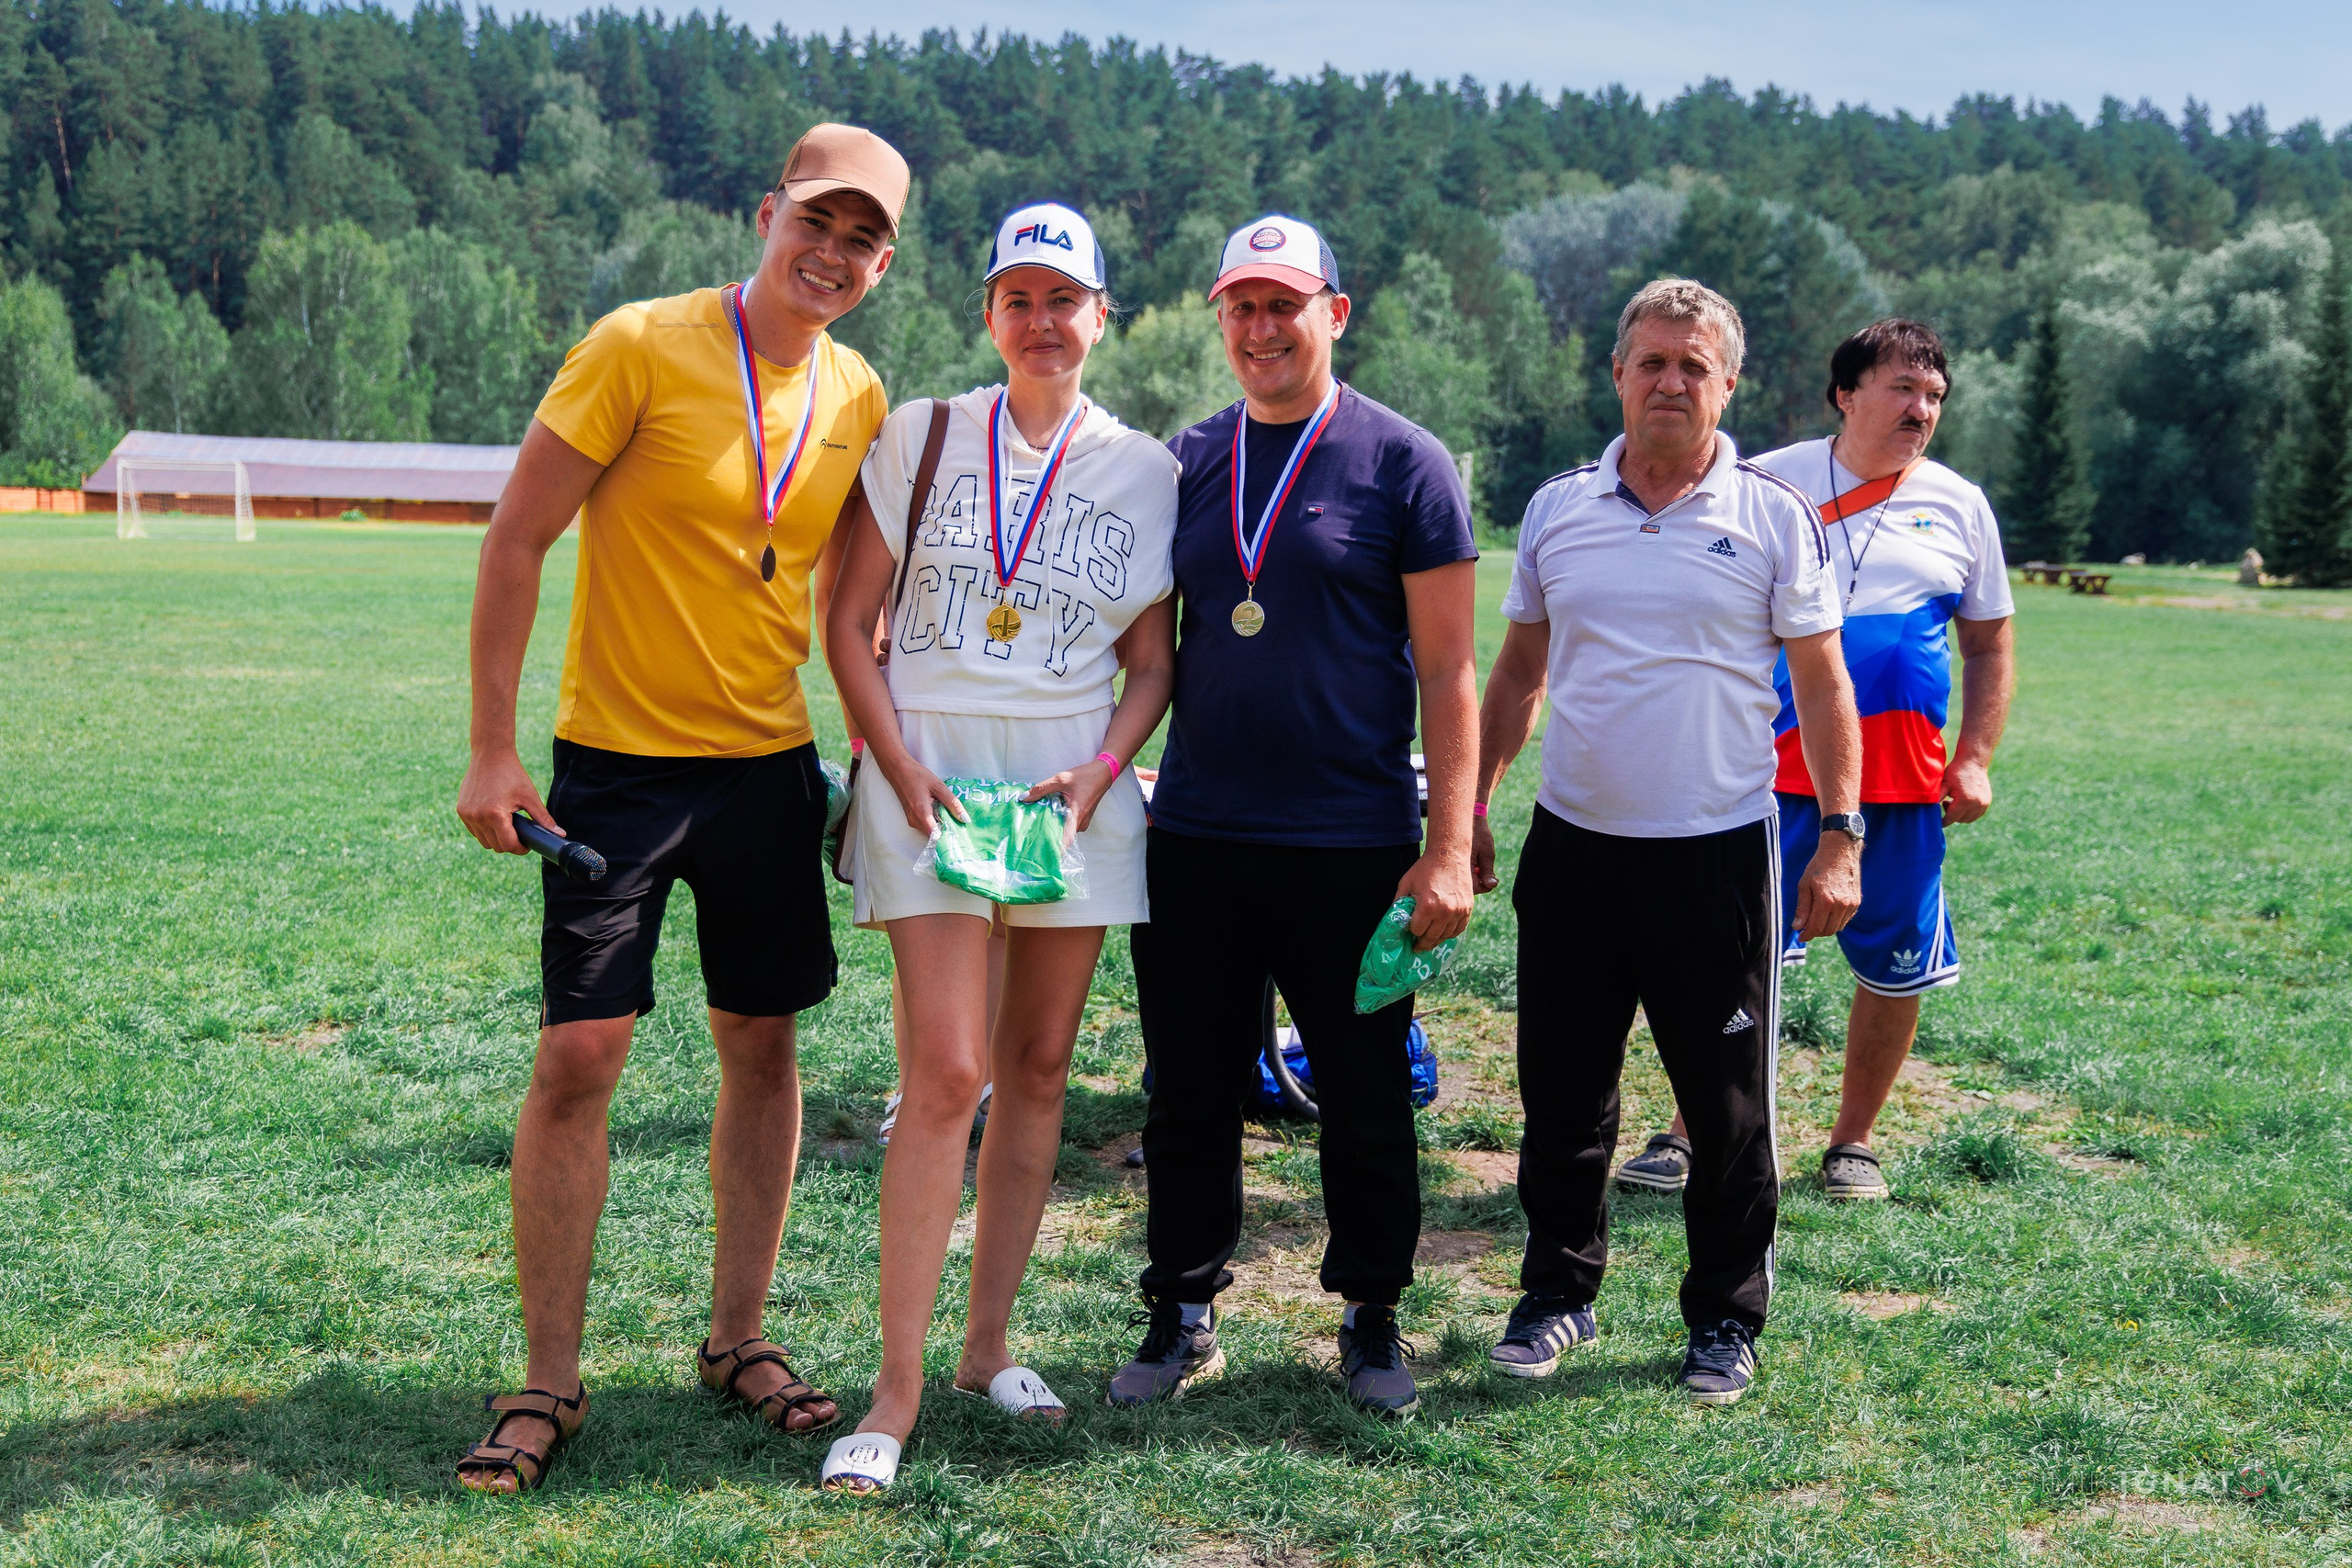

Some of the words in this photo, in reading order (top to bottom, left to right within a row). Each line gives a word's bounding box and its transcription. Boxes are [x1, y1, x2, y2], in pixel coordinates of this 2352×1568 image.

[1014, 223, 1073, 251] FILA
[1707, 545, 1736, 558] adidas
[899, 564, 1095, 678] CITY
[1890, 965, 1920, 975] adidas
[1723, 1019, 1754, 1034] adidas
